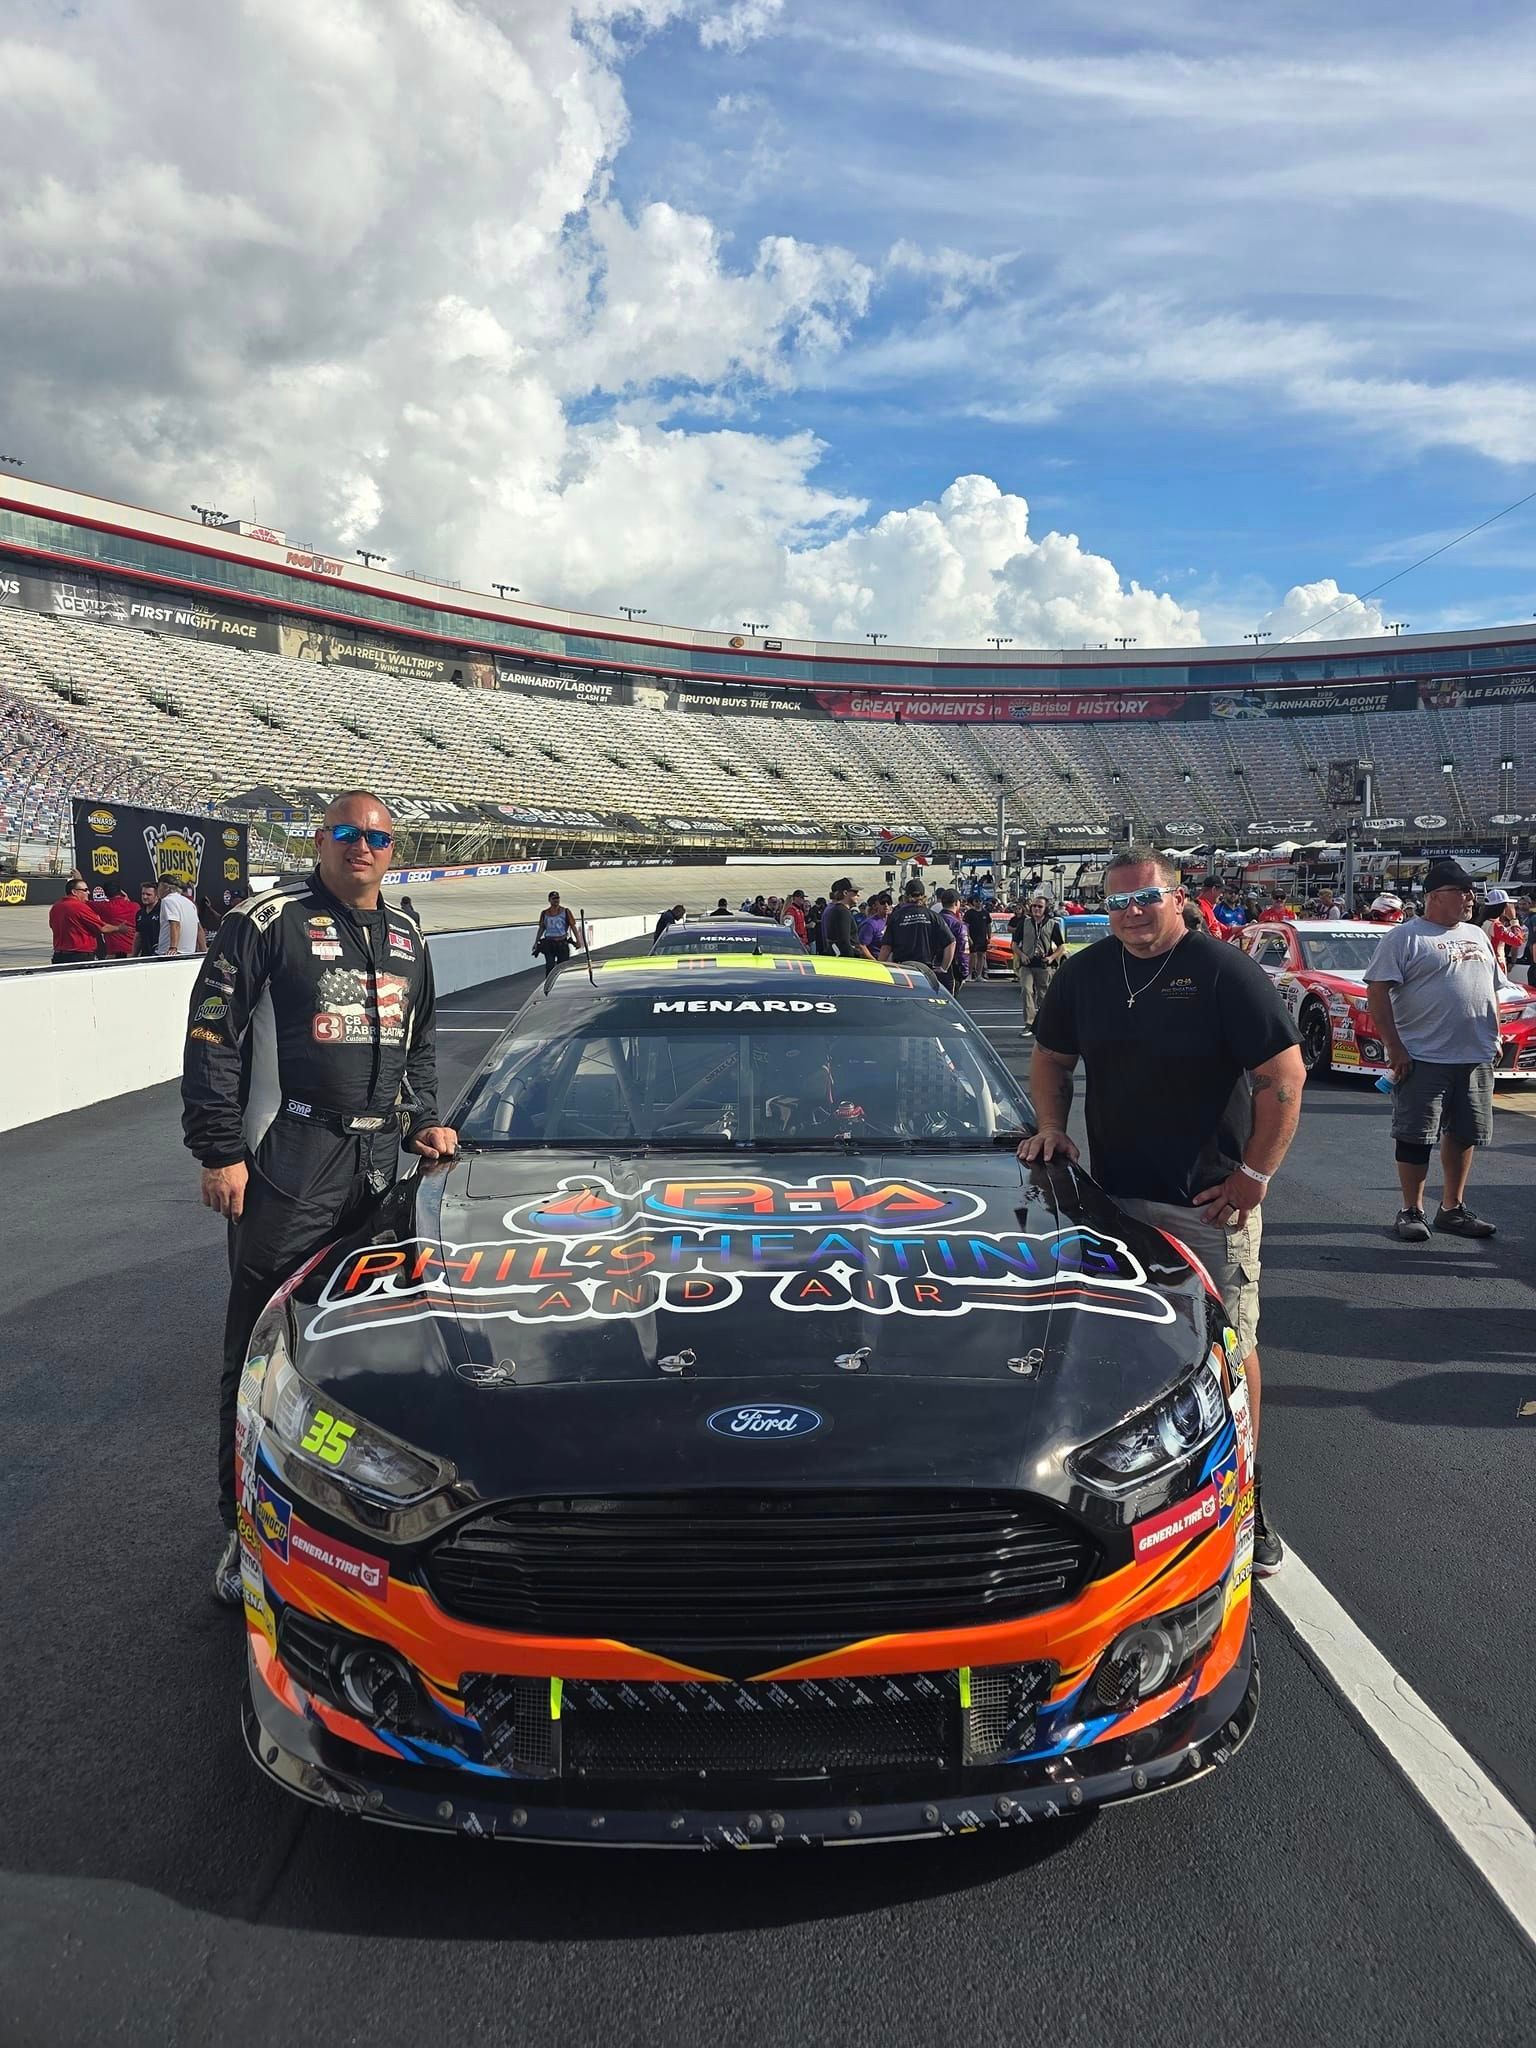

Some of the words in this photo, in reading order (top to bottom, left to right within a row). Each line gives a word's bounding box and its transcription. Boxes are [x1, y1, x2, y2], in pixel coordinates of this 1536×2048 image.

[131, 604, 173, 621] FIRST
[175, 611, 219, 631] NIGHT
[221, 621, 257, 638] RACE
[338, 644, 387, 662] DARRELL
[389, 653, 445, 671] WALTRIP'S
[374, 662, 379, 670] 7
[380, 663, 399, 674] WINS
[400, 666, 408, 675] IN
[409, 668, 415, 676] A
[416, 669, 434, 679] ROW
[500, 671, 613, 696] EARNHARDT/LABONTE
[576, 693, 599, 702] CLASH
[679, 693, 721, 706] BRUTON
[721, 699, 747, 708] BUYS
[750, 699, 769, 709] THE
[770, 700, 802, 711] TRACK
[1264, 695, 1388, 711] EARNHARDT/LABONTE
[1451, 689, 1483, 700] DALE
[851, 698, 903, 714] GREAT
[906, 702, 986, 716] MOMENTS
[989, 705, 1002, 715] in
[1032, 702, 1072, 712] Bristol
[1076, 700, 1149, 715] HISTORY
[1350, 705, 1374, 713] CLASH
[88, 815, 117, 826] MENARDS
[1365, 820, 1403, 828] BUSH'S
[880, 843, 929, 853] SUNOCO
[94, 853, 118, 868] BUSH'S
[159, 848, 194, 876] BUSH'S
[382, 872, 401, 885] EICO
[407, 871, 432, 883] GEICO
[477, 865, 501, 876] GEICO
[508, 863, 534, 873] GEICO
[5, 885, 26, 898] BUSH'S
[257, 905, 276, 922] OMP
[653, 1000, 837, 1014] MENARDS
[345, 1015, 362, 1025] CB
[288, 1102, 312, 1114] OMP
[344, 1236, 655, 1293] PHIL'S
[670, 1233, 1116, 1274] HEATING
[537, 1280, 714, 1310] AND
[799, 1278, 943, 1304] AIR
[730, 1408, 799, 1432] Ford
[300, 1410, 357, 1465] 35
[257, 1502, 286, 1540] SUNOCO
[1138, 1522, 1183, 1552] GENERAL
[1183, 1507, 1203, 1529] TIRE
[291, 1535, 335, 1569] GENERAL
[336, 1552, 360, 1577] TIRE
